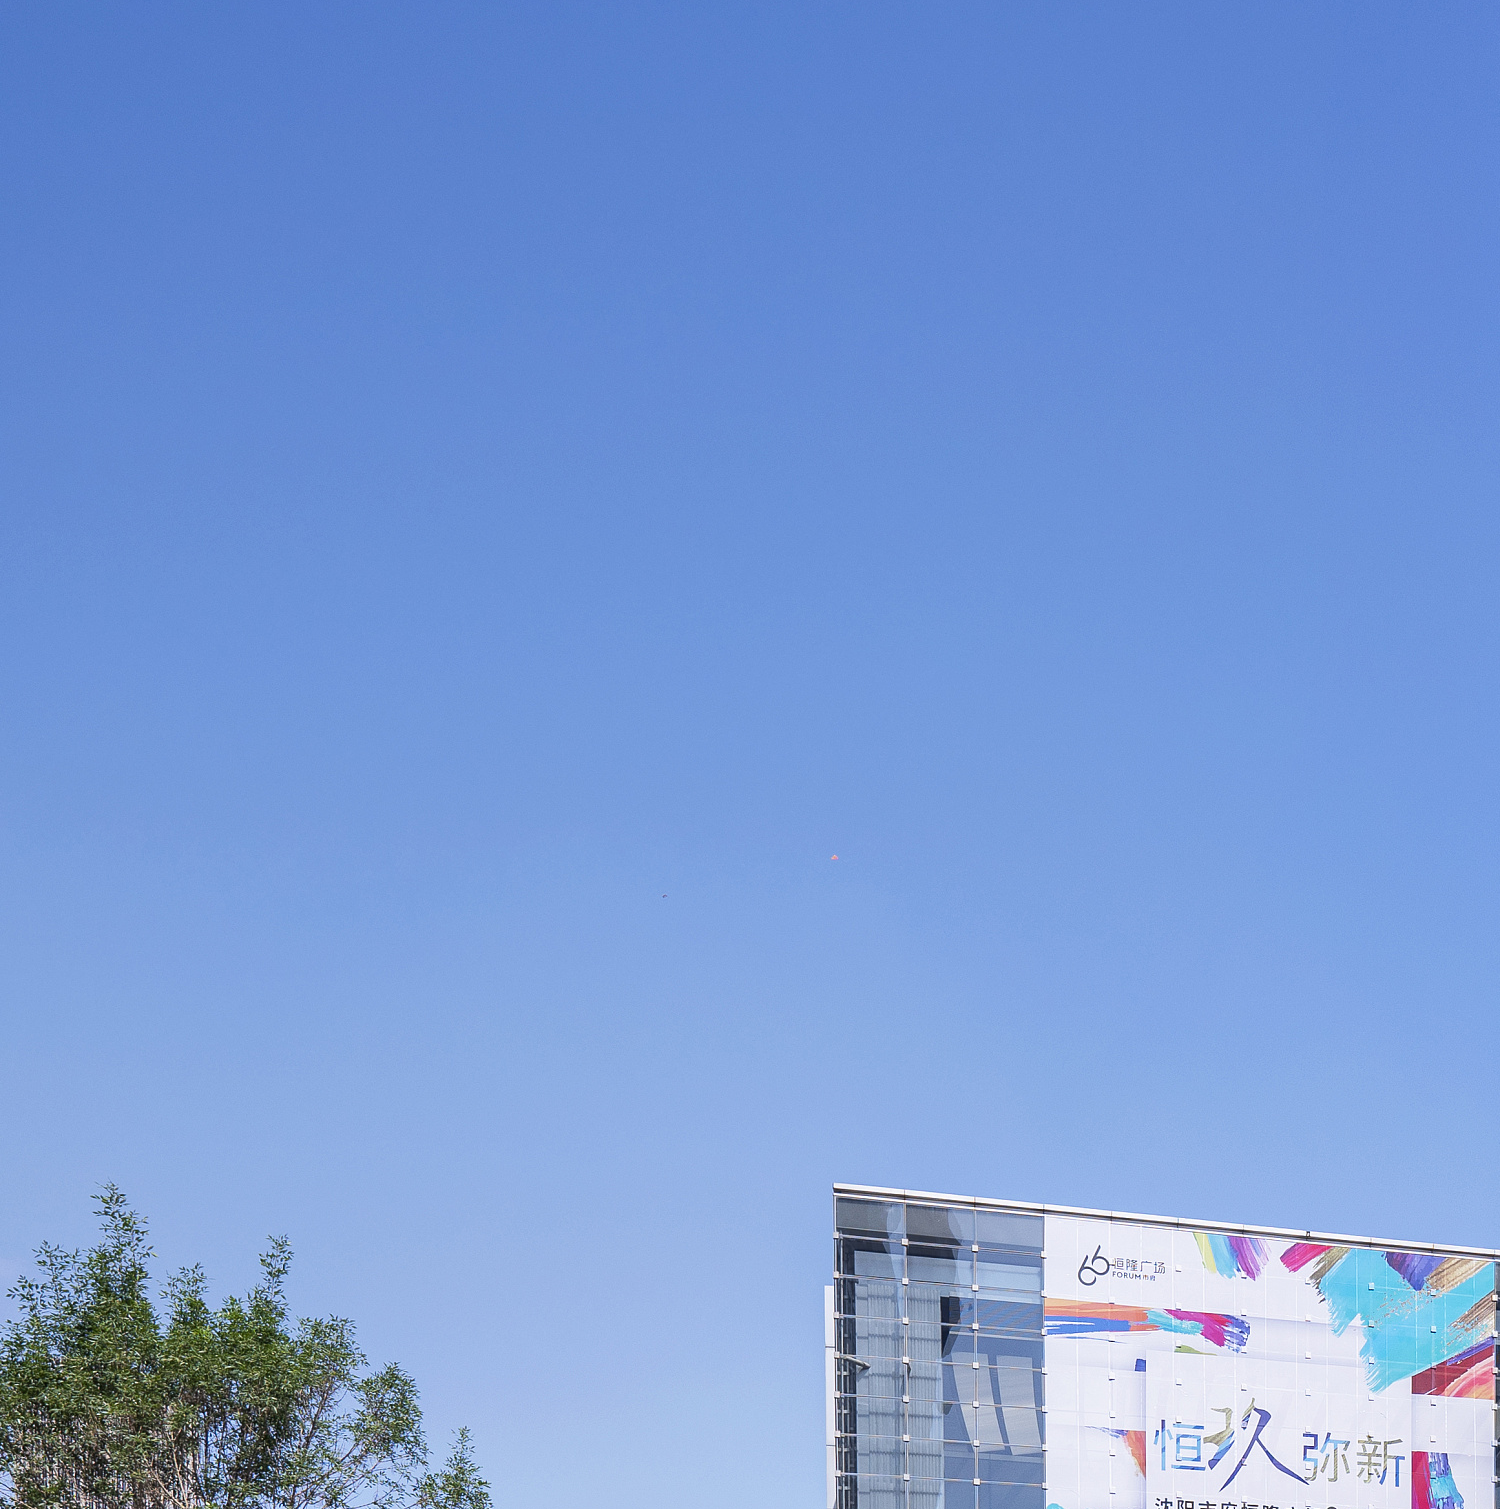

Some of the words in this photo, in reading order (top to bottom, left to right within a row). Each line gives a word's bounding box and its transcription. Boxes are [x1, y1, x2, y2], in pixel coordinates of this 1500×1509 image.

[1112, 1257, 1166, 1275] 恒隆广场
[1112, 1271, 1141, 1281] FORUM
